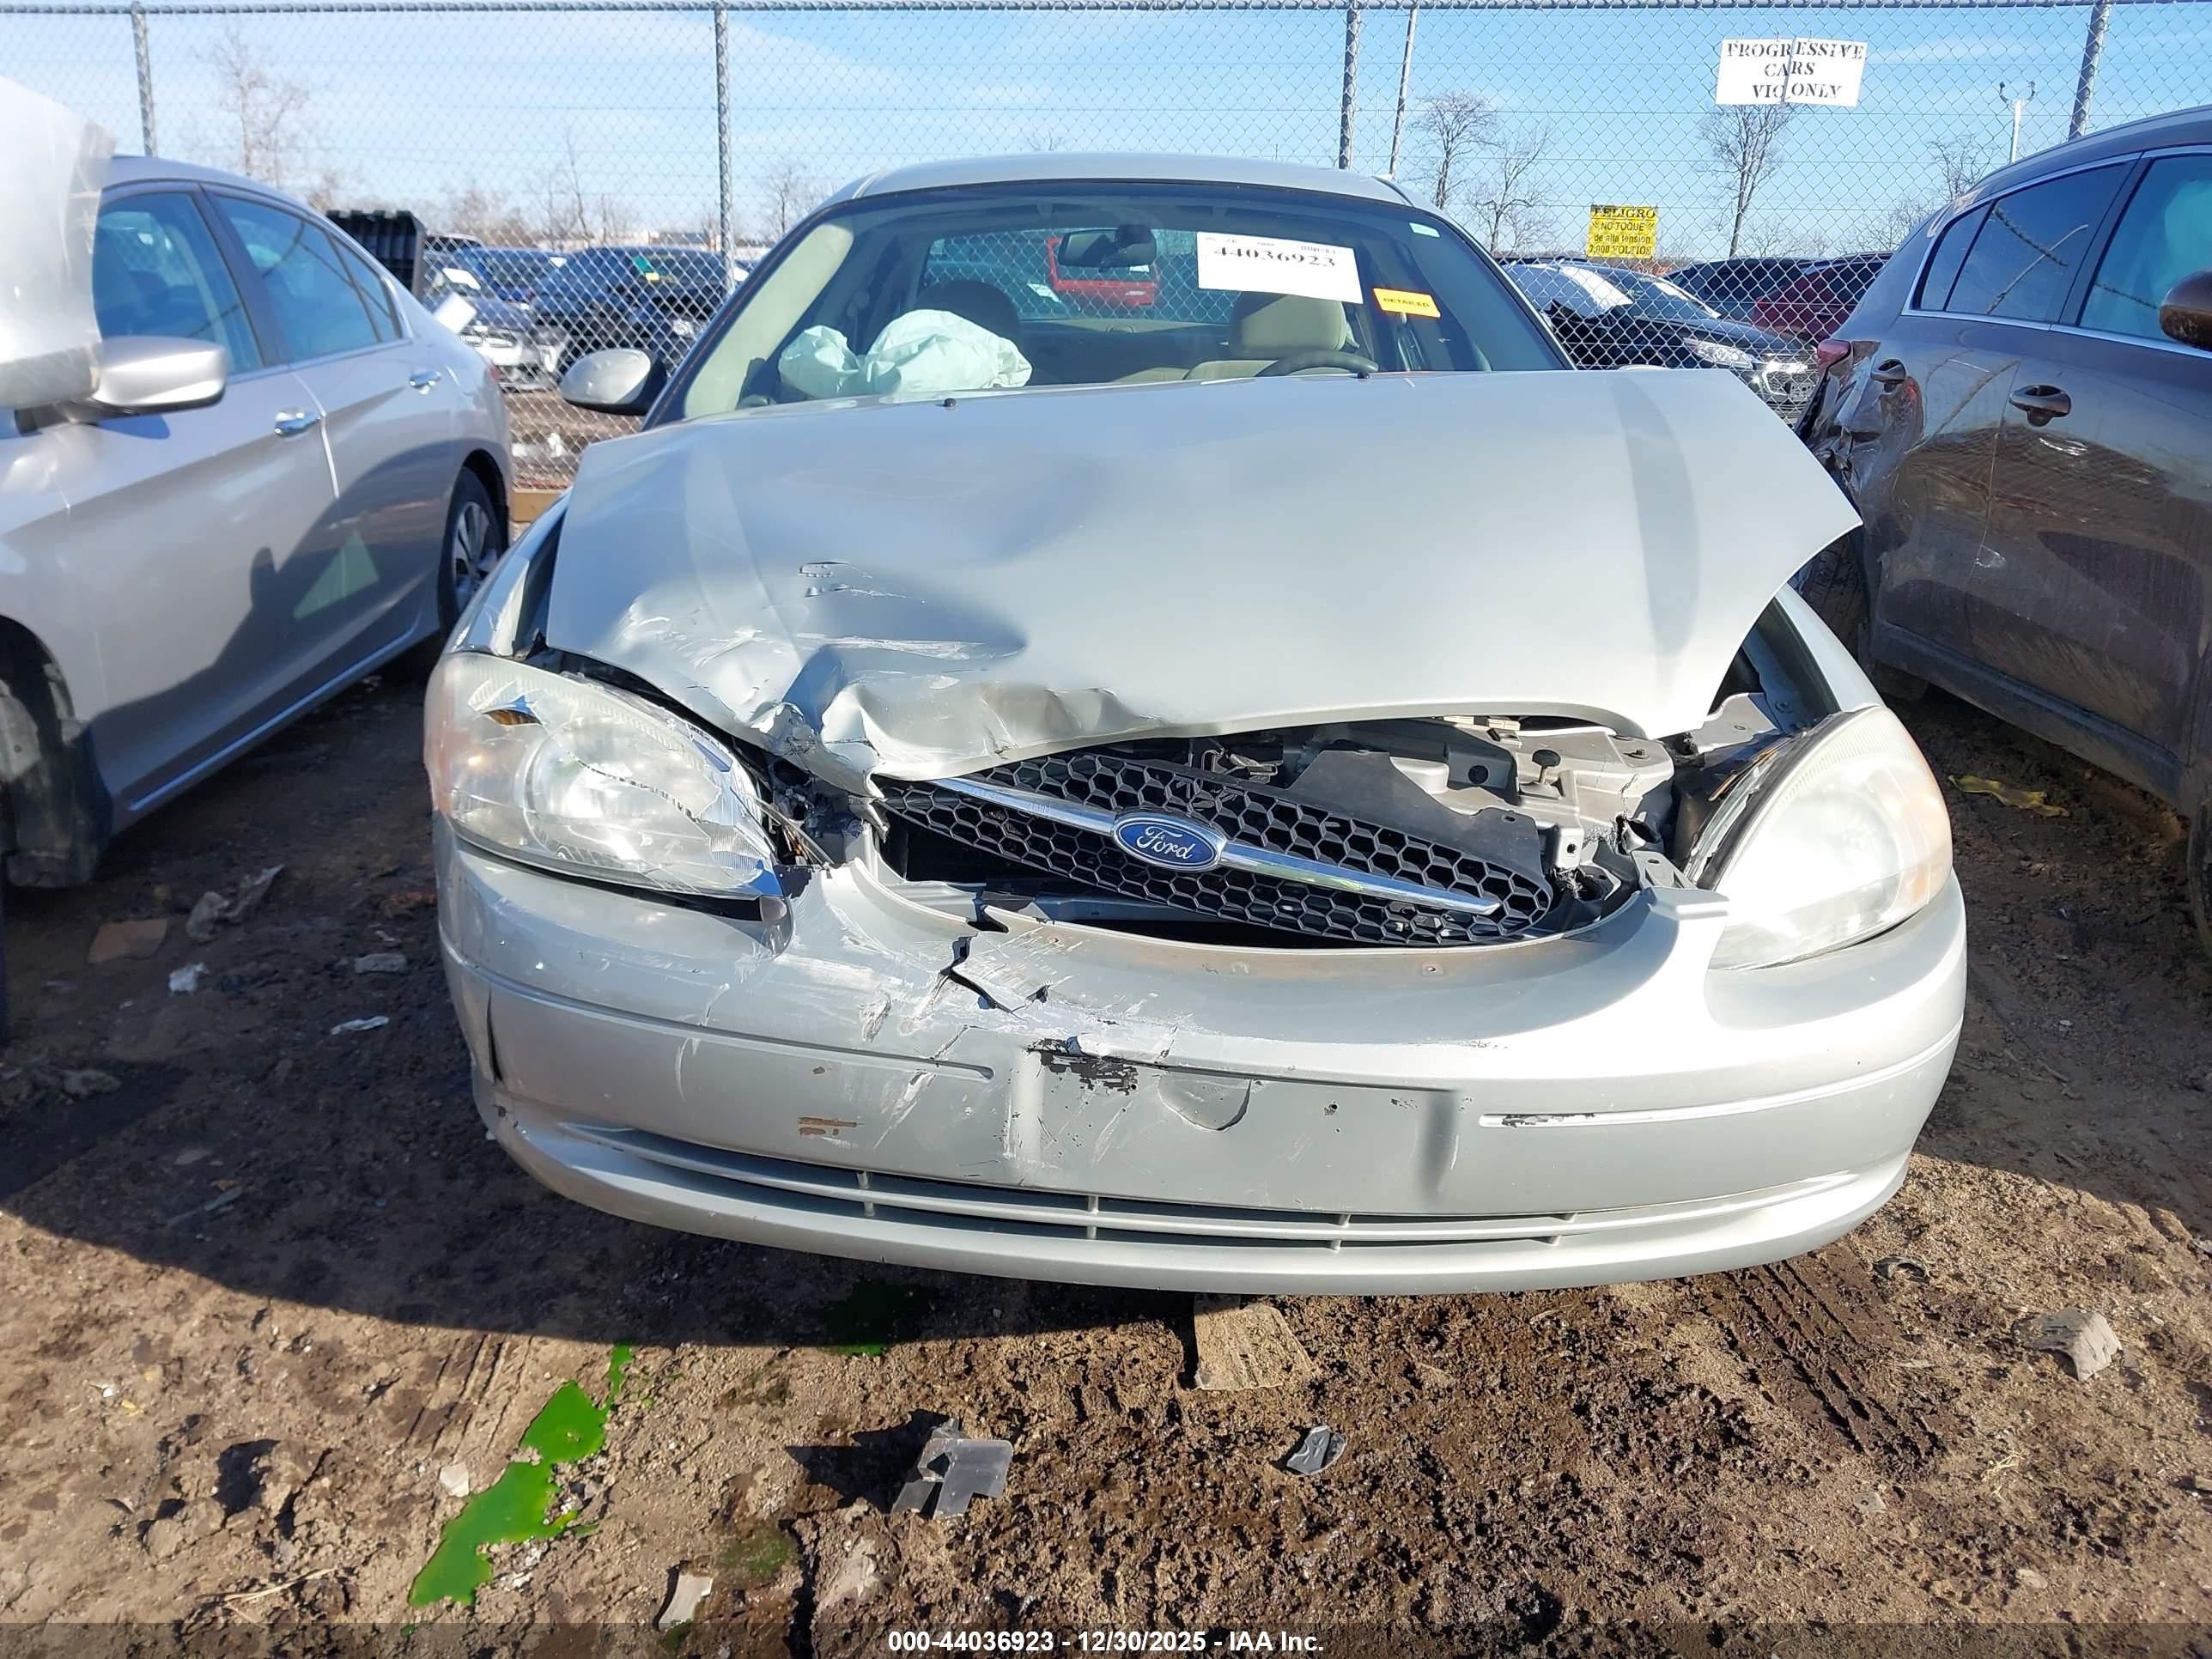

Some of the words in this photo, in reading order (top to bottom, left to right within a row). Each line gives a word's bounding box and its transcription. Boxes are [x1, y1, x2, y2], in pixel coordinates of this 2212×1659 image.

[1728, 41, 1863, 60] PROGRESSIVE
[1764, 60, 1815, 76] CARS
[1791, 82, 1842, 99] ONLY
[1594, 208, 1656, 219] PELIGRO
[1601, 222, 1613, 230] NO
[1615, 222, 1644, 231] TOQUE
[1214, 246, 1336, 267] 44036923
[1136, 826, 1196, 860] Ford
